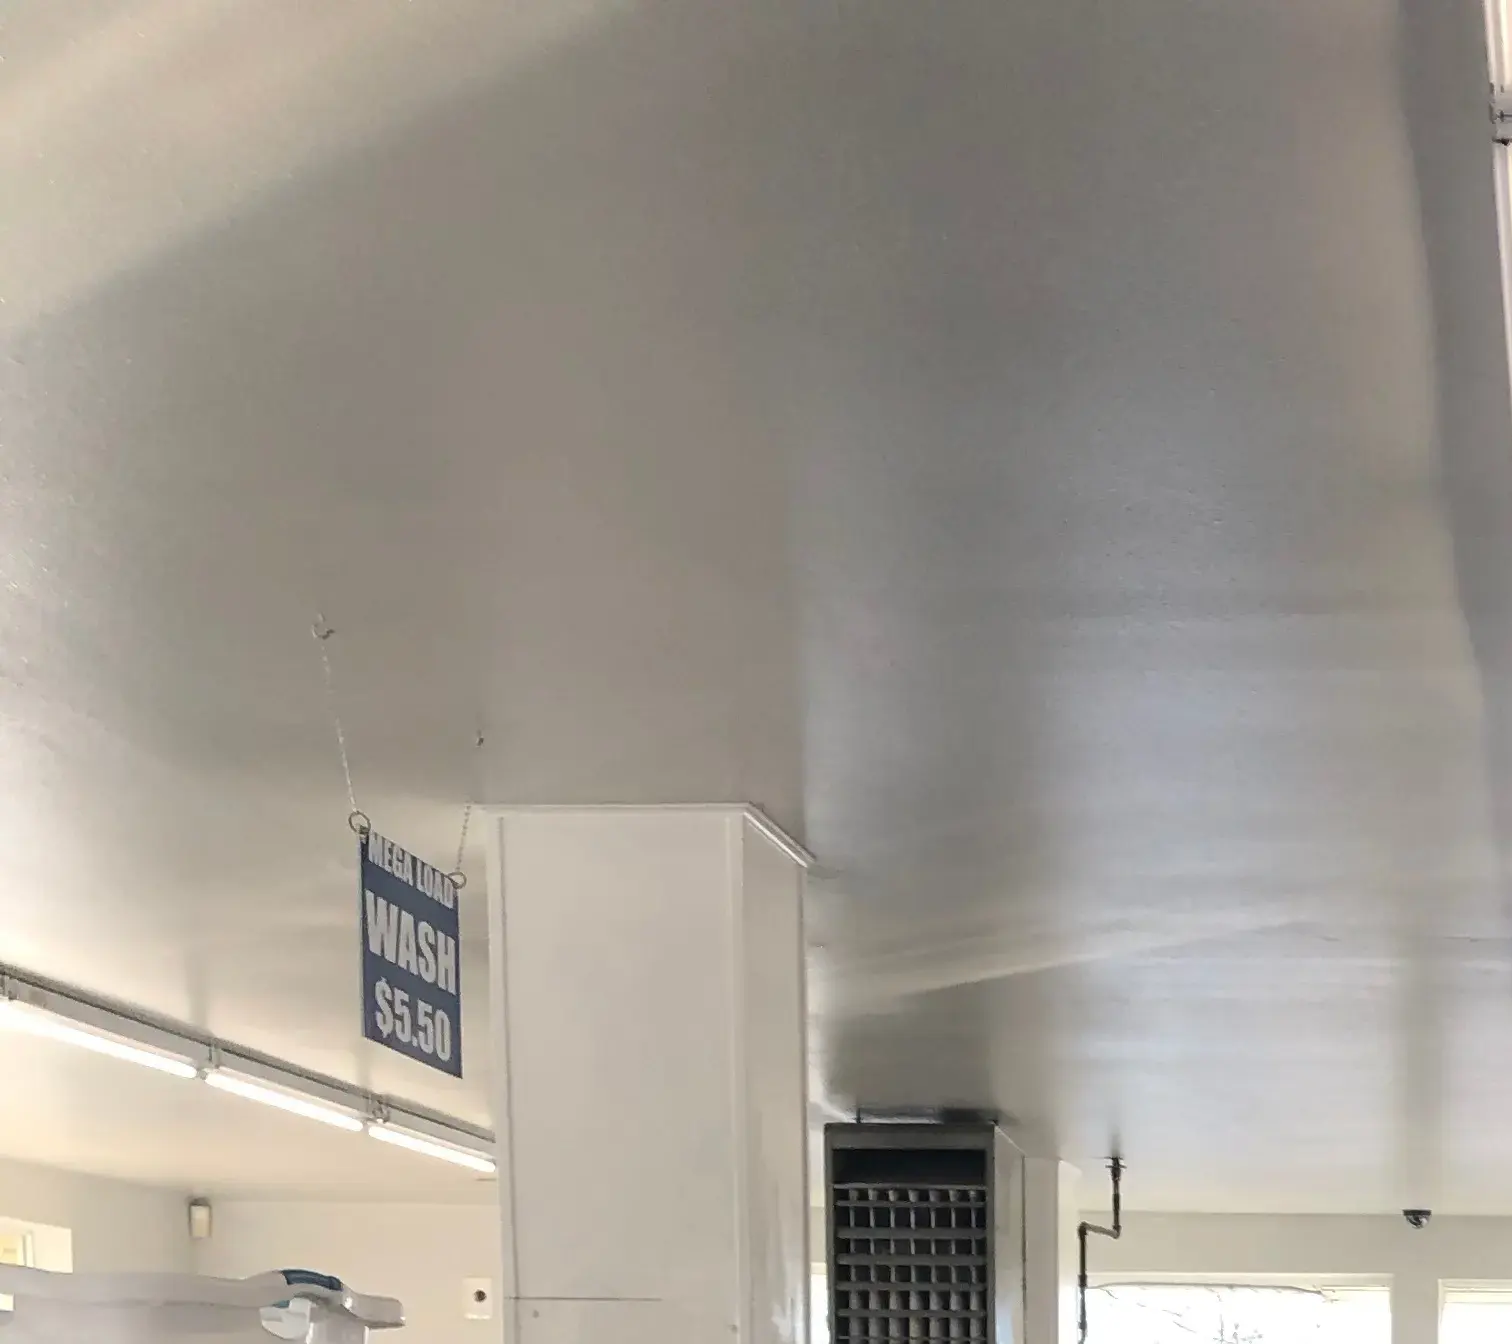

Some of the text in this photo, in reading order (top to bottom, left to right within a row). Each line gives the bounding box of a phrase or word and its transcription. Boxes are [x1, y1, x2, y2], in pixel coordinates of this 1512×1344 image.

[368, 830, 454, 909] MEGA LOAD
[365, 888, 457, 997] WASH
[374, 976, 452, 1062] $5.50
